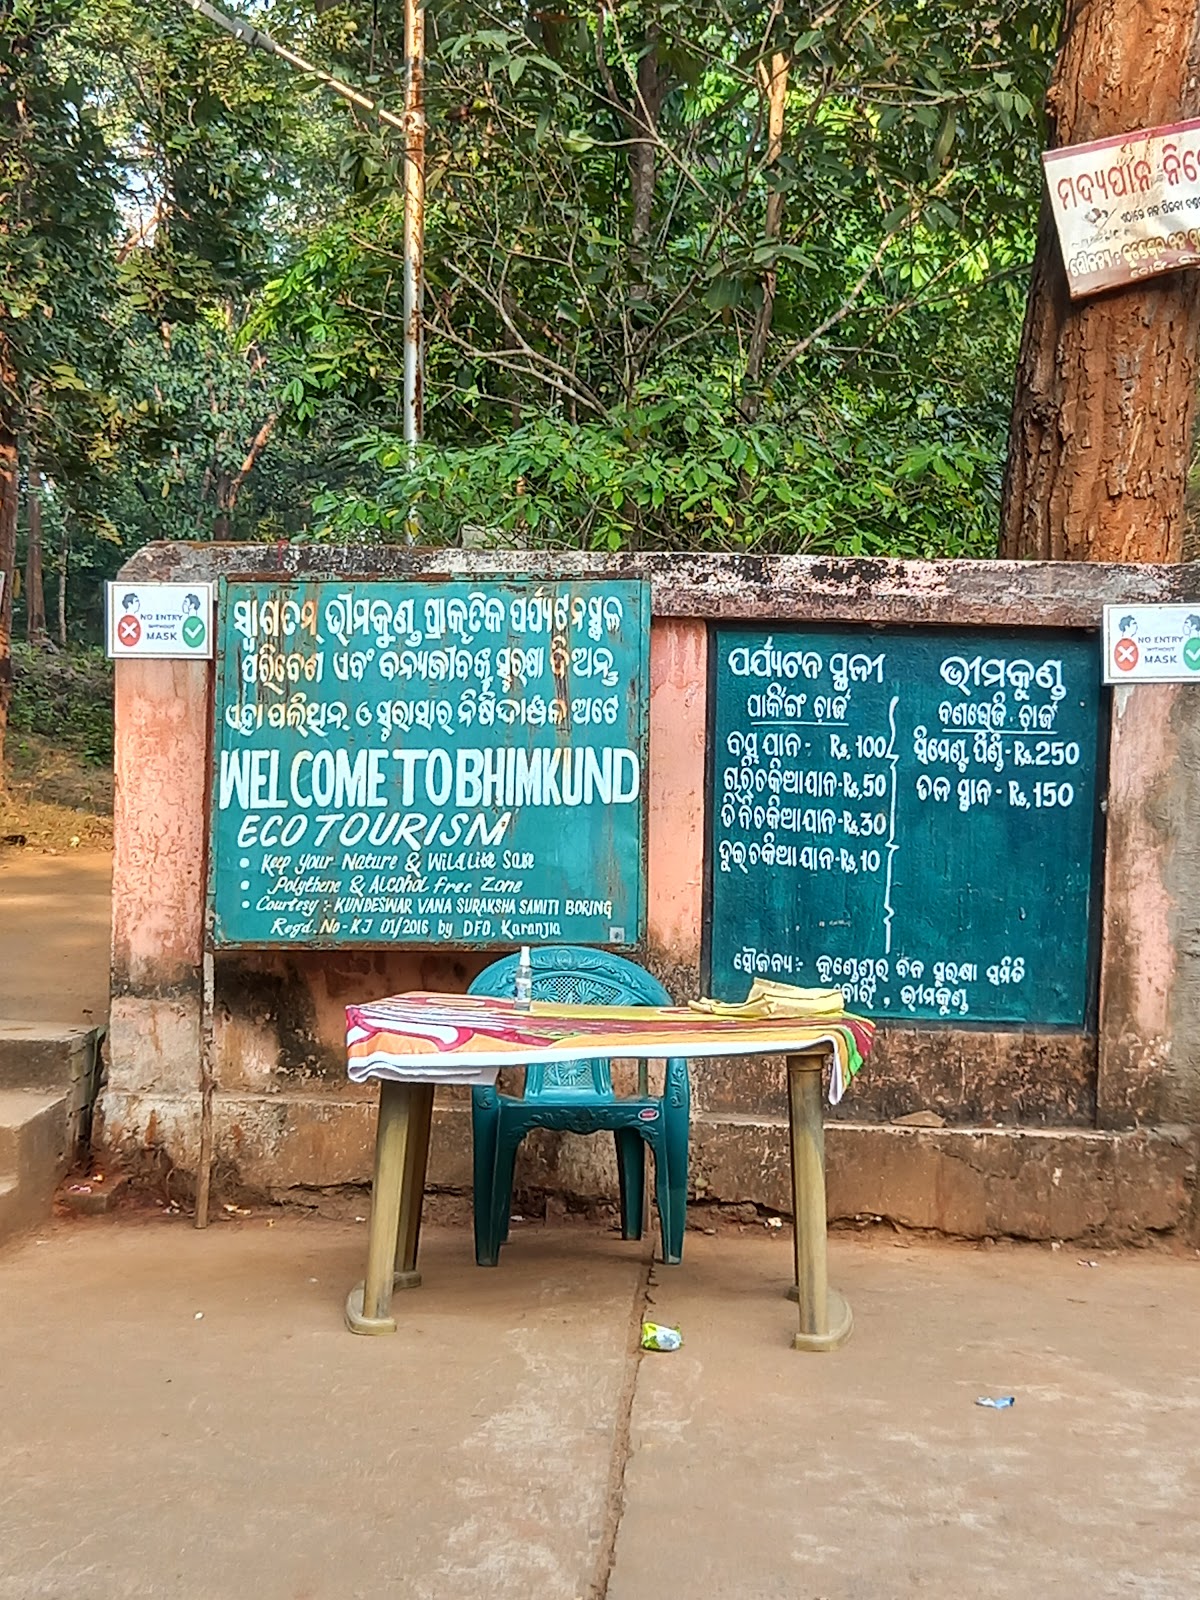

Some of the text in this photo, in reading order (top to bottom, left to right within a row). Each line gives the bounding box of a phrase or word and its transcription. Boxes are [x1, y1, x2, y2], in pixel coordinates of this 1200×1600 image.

[140, 613, 183, 621] NO ENTRY
[146, 632, 178, 641] MASK
[1137, 636, 1184, 644] NO ENTRY
[333, 648, 375, 681] ଏବଂ
[1144, 655, 1178, 664] MASK
[939, 655, 1067, 701] ଭୀମକୁଣ୍ଡ
[355, 701, 373, 727] ଓ
[219, 747, 640, 810] WELCOME TO BHIMKUND
[237, 811, 513, 852] ECO TOURISM
[261, 853, 291, 877] Keep
[341, 852, 398, 871] Nature
[405, 851, 420, 877] &
[267, 876, 342, 897] Polythene
[350, 875, 366, 897] &
[481, 876, 523, 893] Zone
[333, 897, 413, 914] KUNDESWAR
[418, 897, 452, 914] VANA
[456, 898, 516, 917] SURAKSHA
[519, 899, 560, 916] SAMITI
[565, 900, 612, 919] BORING
[380, 916, 429, 939] 01/2016
[438, 919, 453, 939] by
